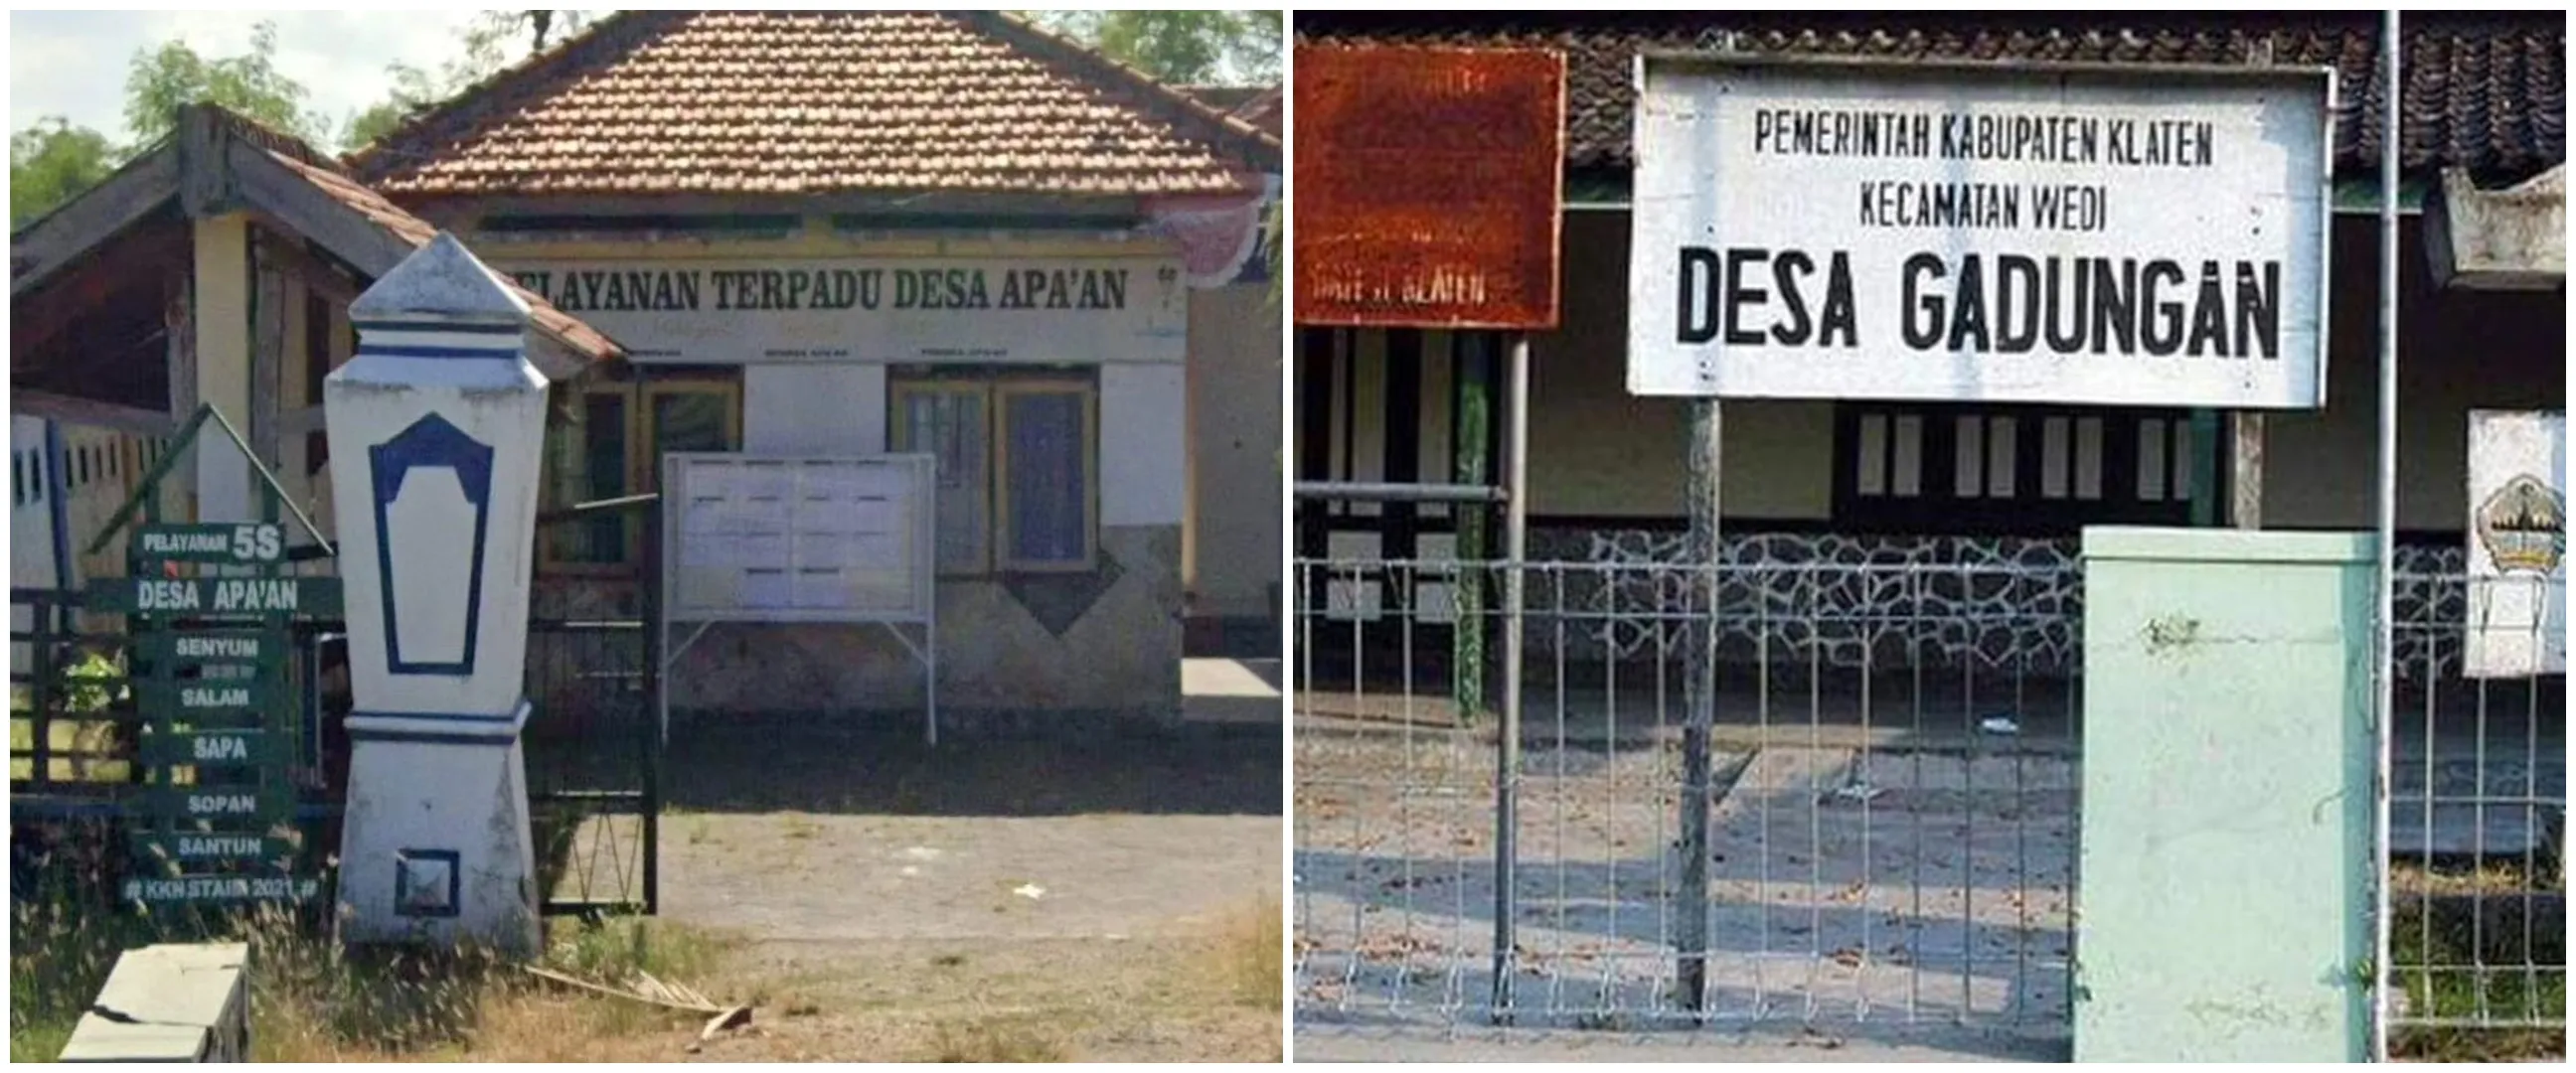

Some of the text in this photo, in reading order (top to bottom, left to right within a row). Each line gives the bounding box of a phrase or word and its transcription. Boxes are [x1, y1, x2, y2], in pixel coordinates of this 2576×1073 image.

[1754, 109, 2214, 167] PEMERINTAH KABUPATEN KLATEN
[1859, 180, 2107, 231] KECAMATAN WEDI
[509, 266, 1130, 311] ELAYANAN TERPADU DESA APA'AN
[1677, 244, 2282, 360] DESA GADUNGAN
[143, 524, 281, 560] PELAYANAN 5S
[137, 579, 298, 611] DESA APA'AN
[176, 637, 258, 657] SENYUM
[181, 688, 249, 707] SALAM
[194, 736, 247, 759] SAPA
[188, 794, 256, 814] SOPAN
[178, 836, 262, 855] SANTUN
